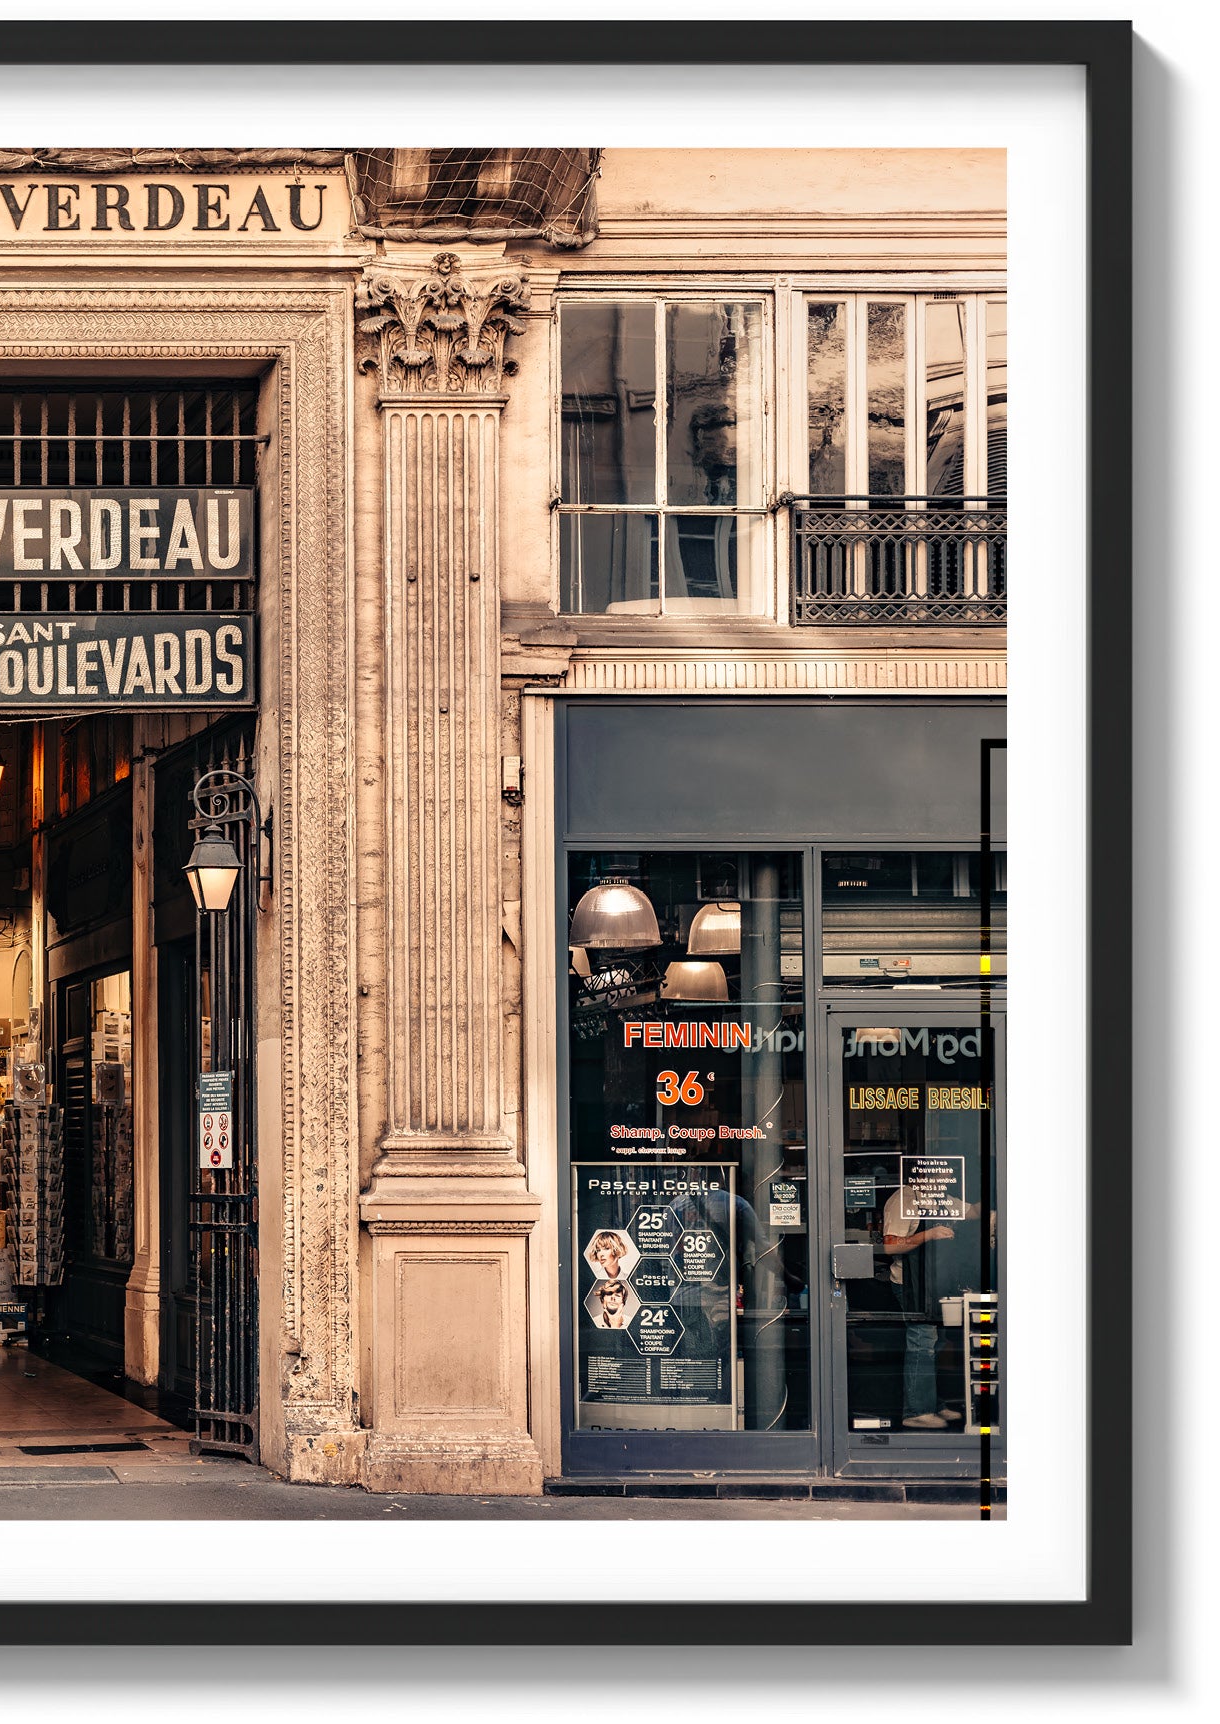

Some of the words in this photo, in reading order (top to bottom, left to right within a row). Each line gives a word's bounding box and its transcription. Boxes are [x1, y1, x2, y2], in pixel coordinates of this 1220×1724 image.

[624, 1022, 752, 1048] FEMININ
[850, 1087, 920, 1110] LISSAGE
[610, 1124, 666, 1142] Shamp.
[669, 1125, 716, 1142] Coupe
[588, 1179, 656, 1190] Pascal
[664, 1179, 720, 1190] Coste
[638, 1212, 668, 1230] 25€
[683, 1236, 712, 1252] 36€
[640, 1309, 669, 1326] 24€
